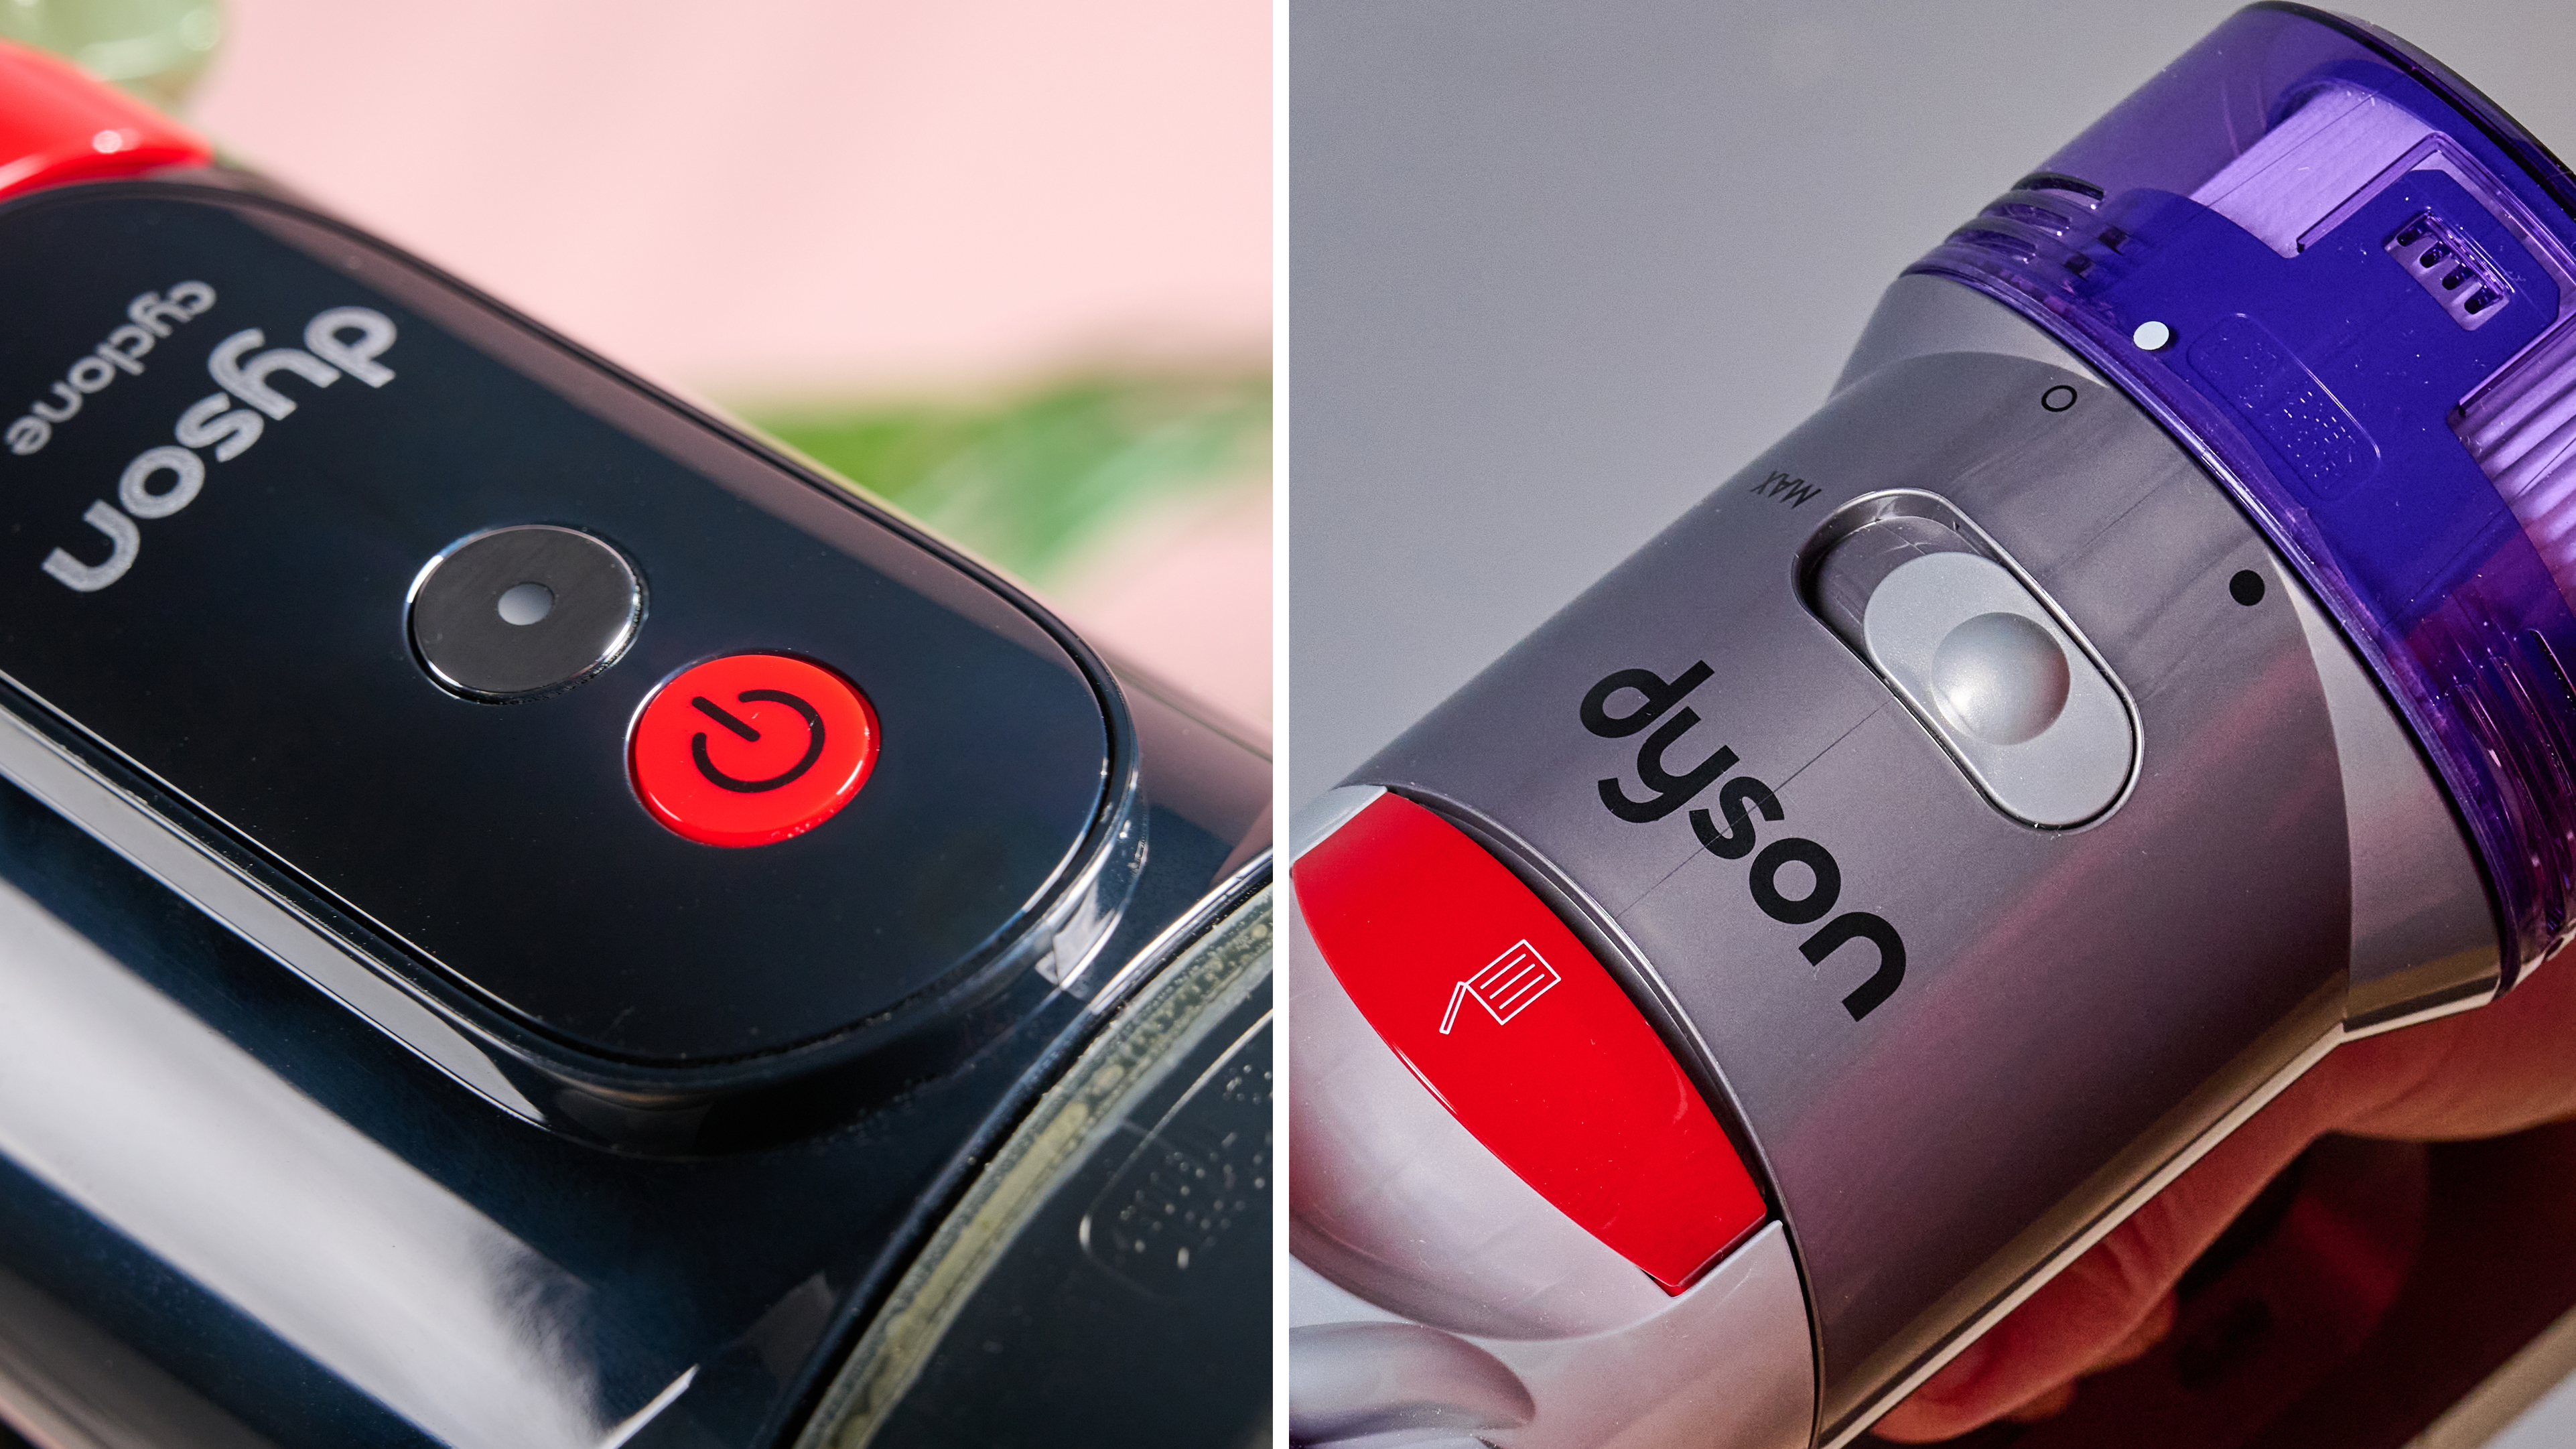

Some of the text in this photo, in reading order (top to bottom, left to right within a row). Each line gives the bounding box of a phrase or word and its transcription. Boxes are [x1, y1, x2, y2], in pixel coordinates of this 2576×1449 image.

[5, 281, 216, 455] cyclone
[42, 306, 397, 592] dyson
[1749, 470, 1822, 509] MAX
[1580, 659, 1907, 1022] dyson
